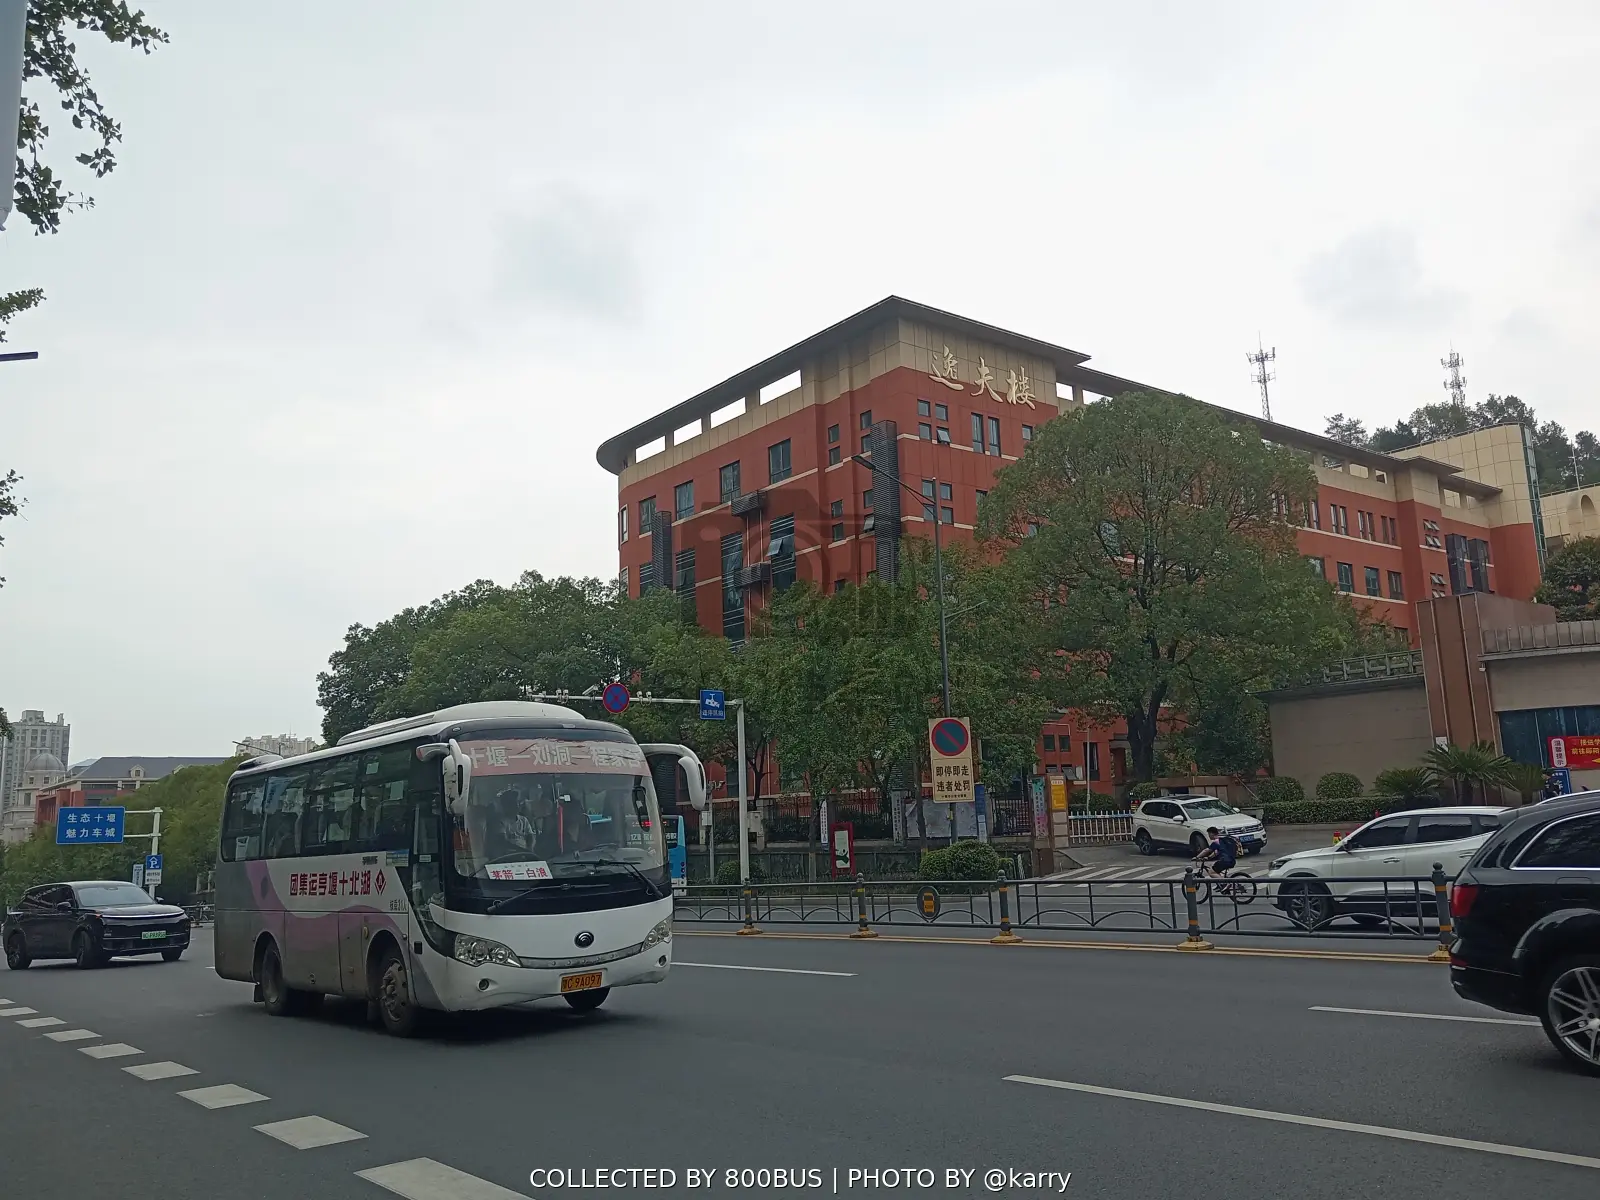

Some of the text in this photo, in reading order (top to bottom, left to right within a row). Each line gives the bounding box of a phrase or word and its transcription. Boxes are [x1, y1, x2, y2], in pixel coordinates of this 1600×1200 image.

[928, 344, 1036, 410] 逸夫楼
[935, 765, 970, 777] 即停即走
[936, 780, 971, 792] 违者处罚
[67, 813, 116, 823] 生态十堰
[65, 828, 116, 839] 魅力车城
